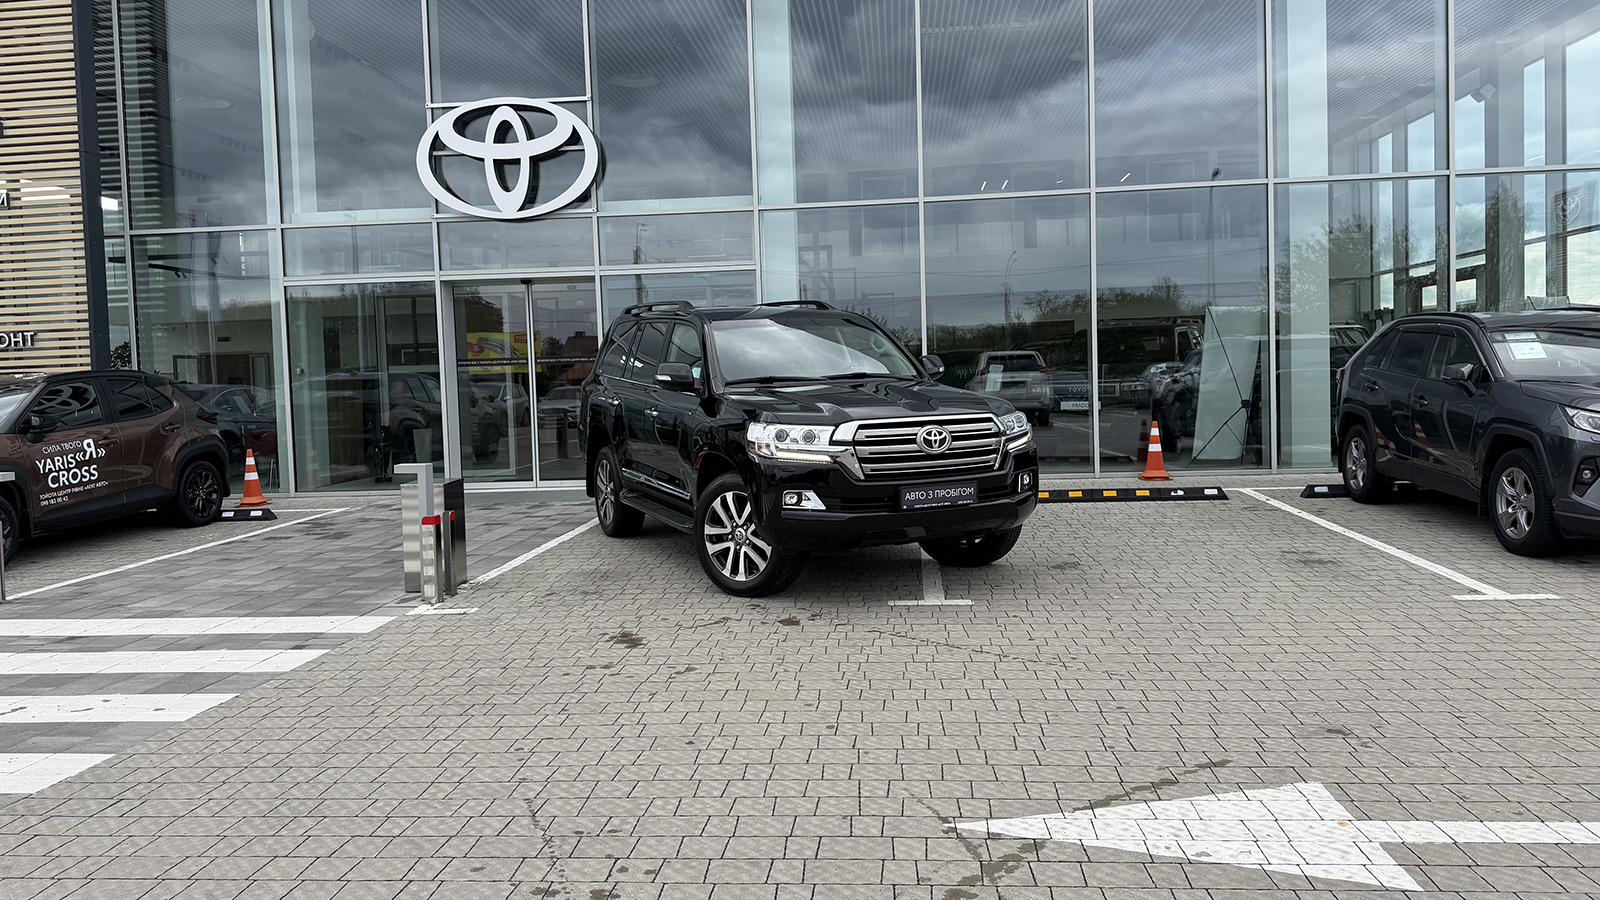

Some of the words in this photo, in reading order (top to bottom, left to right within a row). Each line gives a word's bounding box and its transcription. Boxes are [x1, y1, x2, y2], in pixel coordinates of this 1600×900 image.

[42, 444, 62, 454] СИЛА
[61, 440, 82, 450] ТВОГО
[47, 464, 99, 488] CROSS
[905, 491, 926, 501] АВТО
[927, 490, 933, 499] З
[934, 487, 974, 498] ПРОБІГОМ
